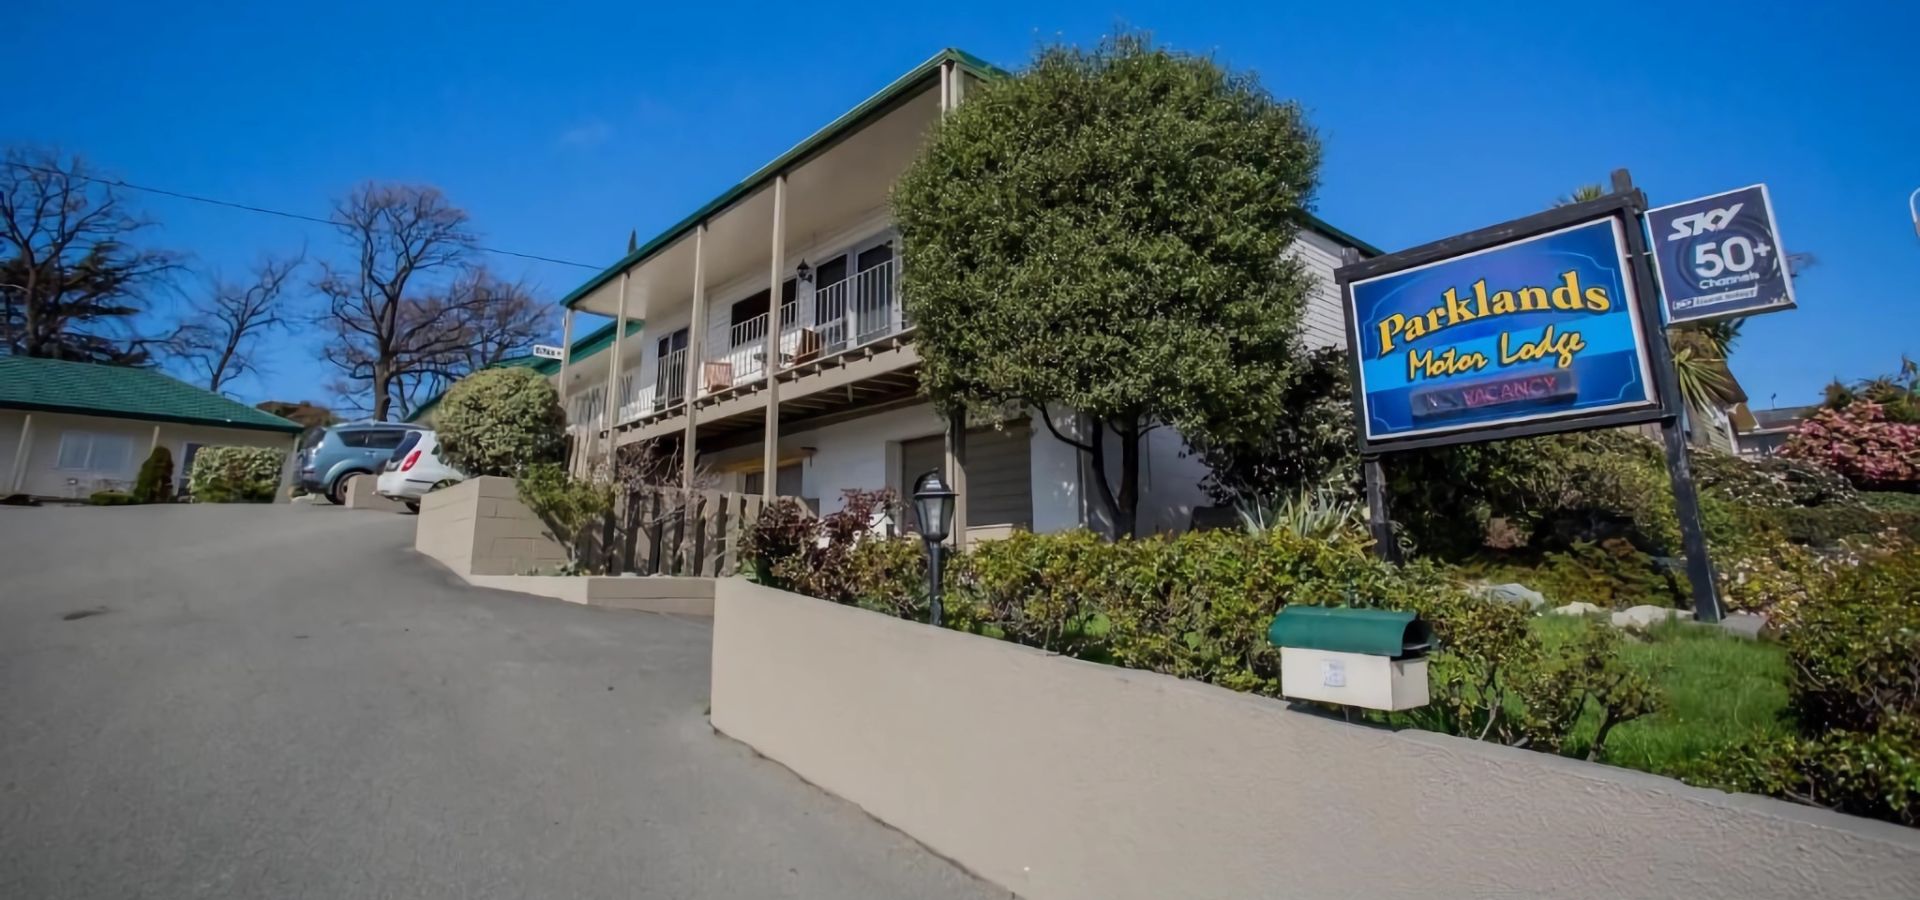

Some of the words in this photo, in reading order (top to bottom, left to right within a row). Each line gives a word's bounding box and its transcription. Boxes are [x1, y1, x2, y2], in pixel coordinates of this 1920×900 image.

[1667, 203, 1744, 241] SKY
[1695, 236, 1771, 278] 50+
[1699, 271, 1760, 290] Channels
[1378, 269, 1611, 356] Parklands
[1407, 347, 1488, 381] Motor
[1499, 325, 1585, 369] Lodge
[1462, 376, 1556, 406] VACANCY
